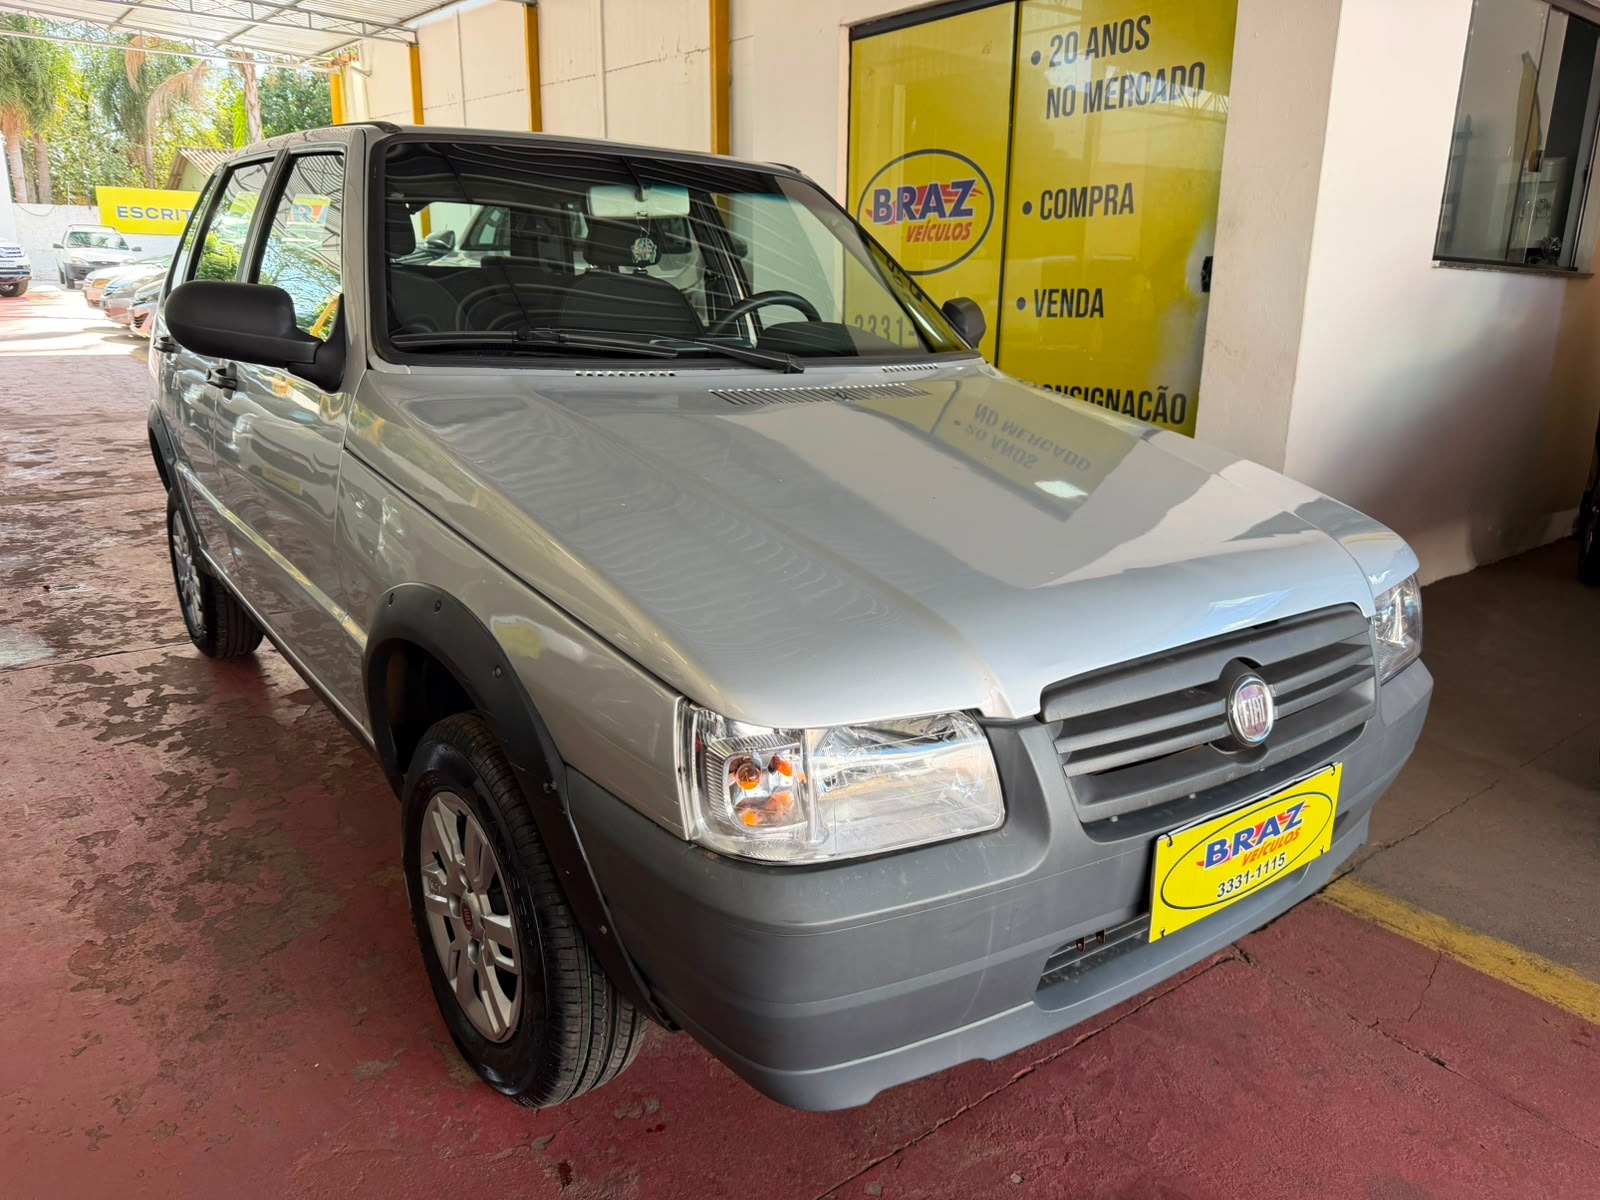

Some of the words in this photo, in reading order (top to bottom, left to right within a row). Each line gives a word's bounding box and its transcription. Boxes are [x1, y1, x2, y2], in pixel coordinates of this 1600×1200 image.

[1049, 31, 1079, 68] 20
[1085, 15, 1151, 61] ANOS
[1046, 85, 1076, 120] NO
[1083, 61, 1206, 114] MERCADO
[872, 178, 977, 224] BRAZ
[1040, 182, 1134, 220] COMPRA
[906, 219, 973, 243] VEÍCULOS
[1034, 288, 1104, 319] VENDA
[1204, 801, 1306, 869] BRAZ
[1242, 827, 1302, 867] VEÍCULOS
[1216, 851, 1287, 899] 3331-1115
